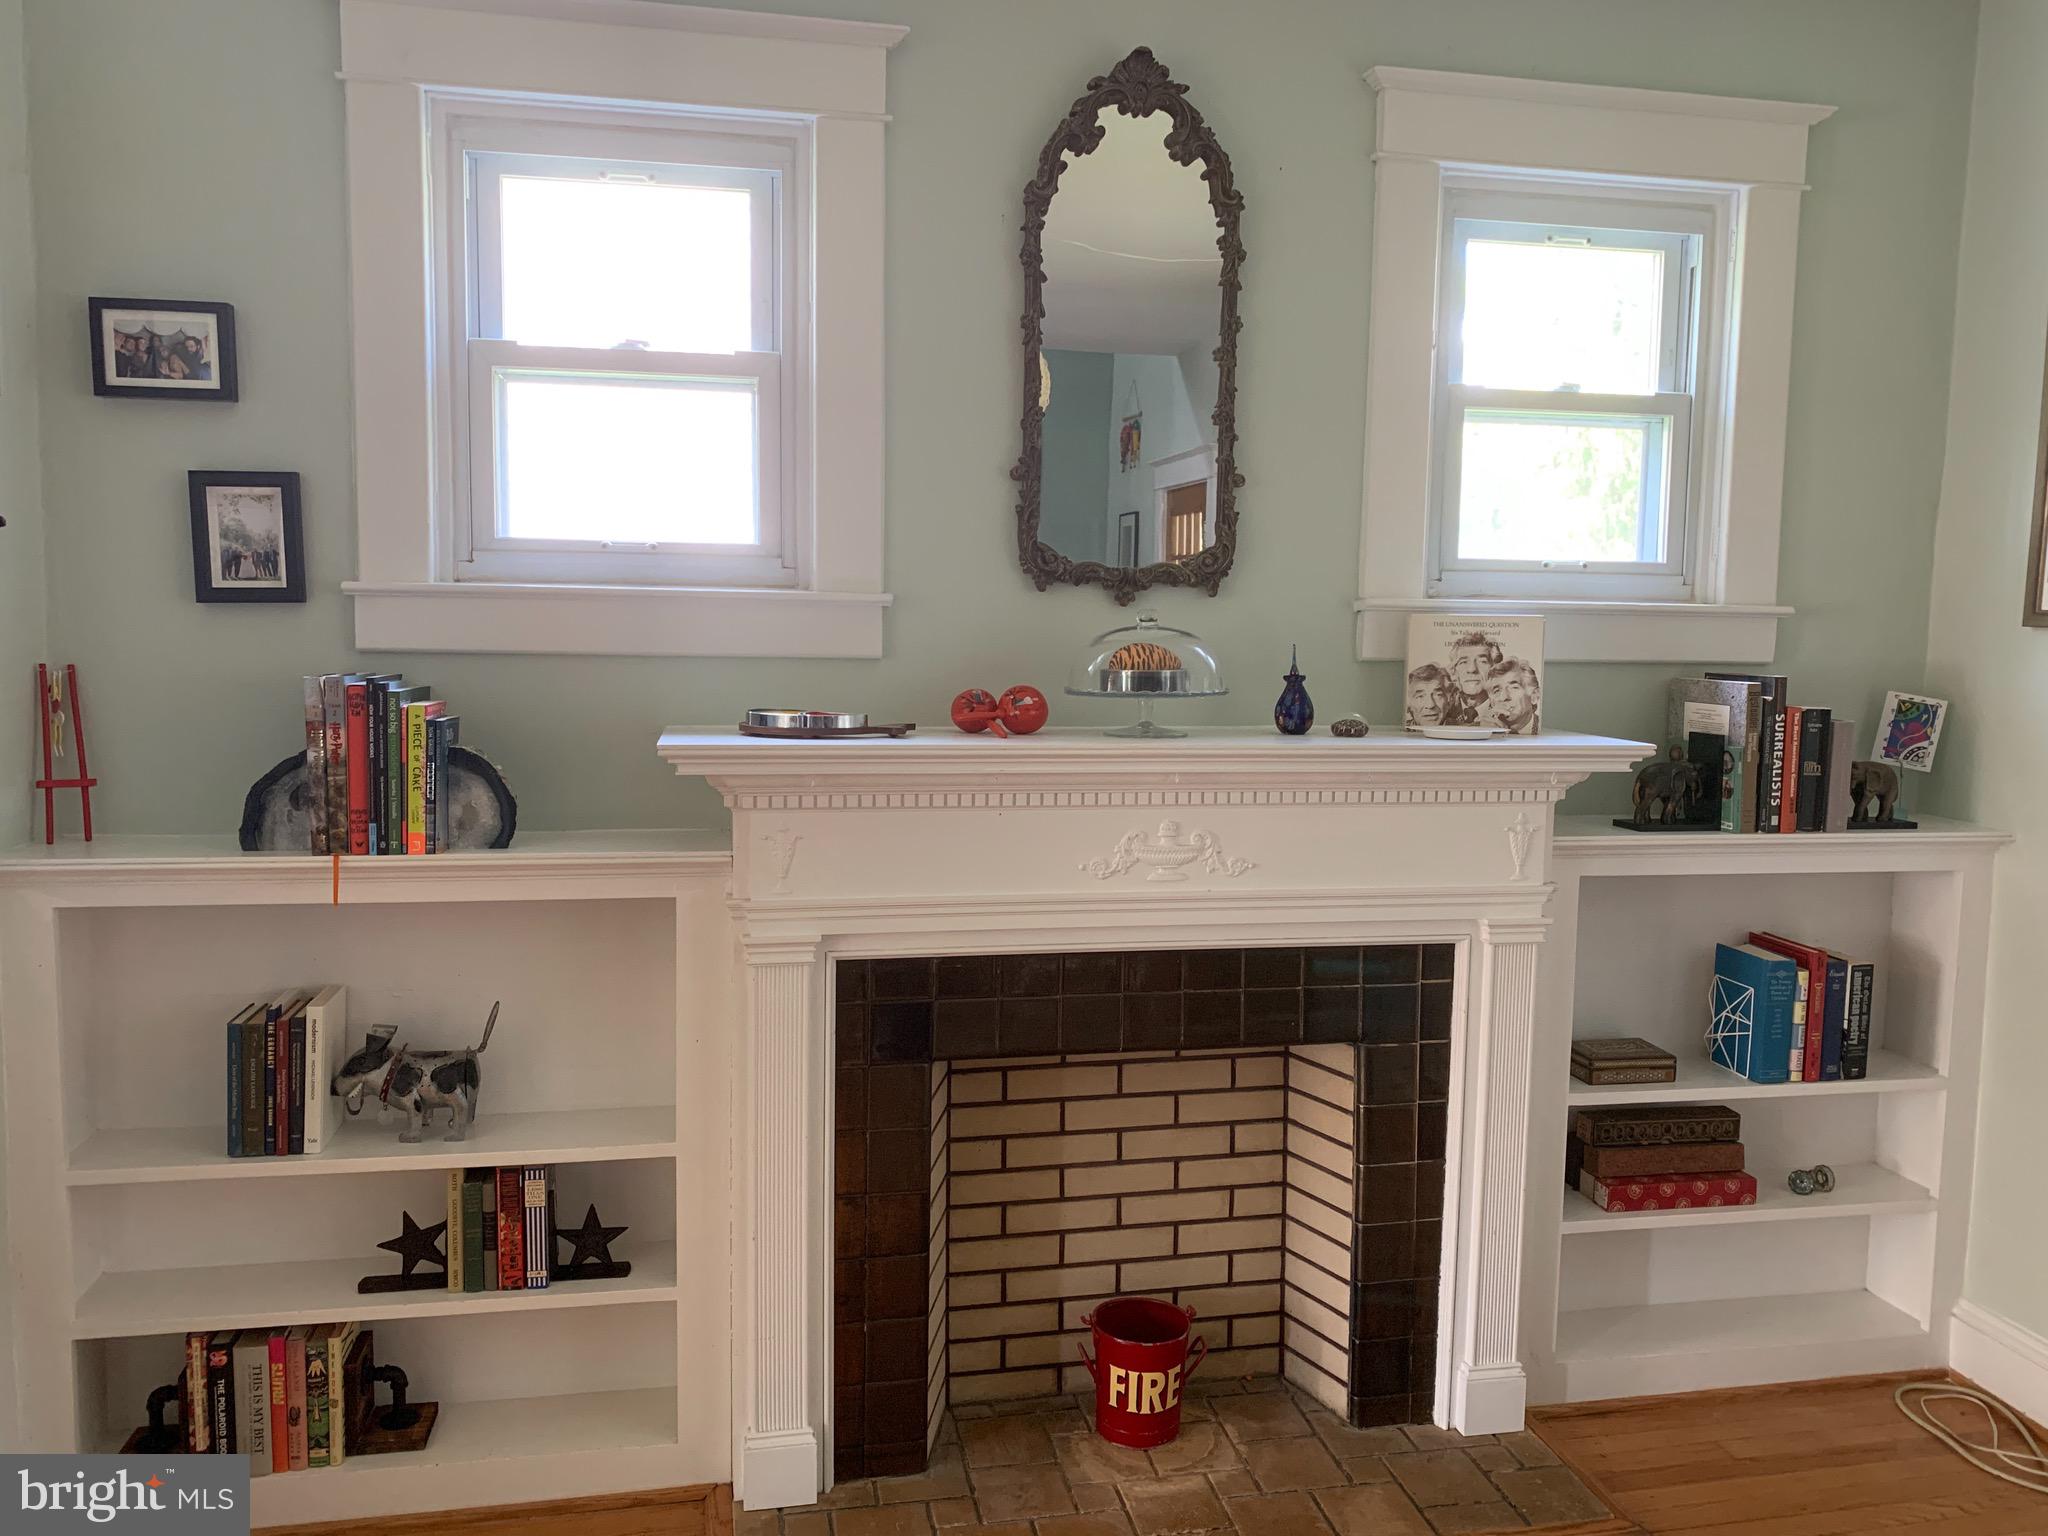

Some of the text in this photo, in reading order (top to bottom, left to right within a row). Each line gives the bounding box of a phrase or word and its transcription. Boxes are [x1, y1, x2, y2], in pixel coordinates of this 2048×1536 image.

[389, 697, 397, 711] not
[389, 712, 396, 721] so
[387, 721, 399, 734] big
[412, 723, 422, 751] PIECE
[1770, 713, 1786, 807] SURREALISTS
[412, 766, 422, 792] CAKE
[1848, 970, 1863, 1045] american poetry
[267, 1021, 275, 1035] THE
[1108, 1363, 1181, 1415] FIRE
[217, 1378, 228, 1455] THE POLAROID BOO
[252, 1364, 265, 1455] THIS IS MY BEST
